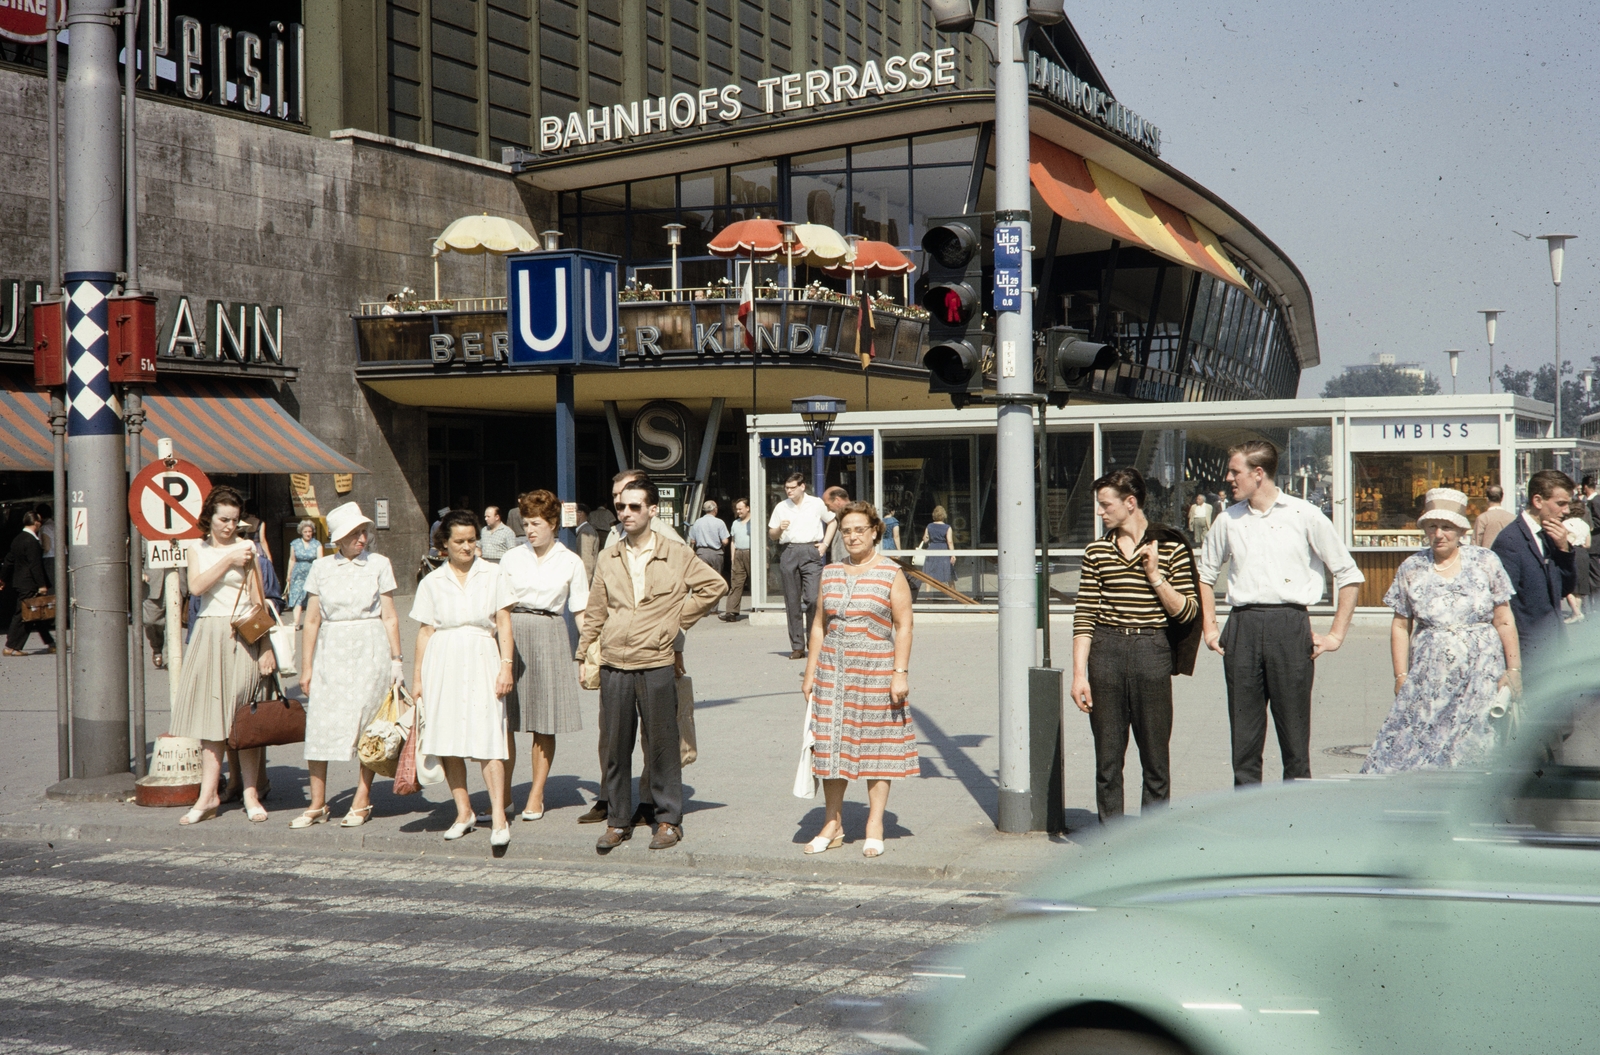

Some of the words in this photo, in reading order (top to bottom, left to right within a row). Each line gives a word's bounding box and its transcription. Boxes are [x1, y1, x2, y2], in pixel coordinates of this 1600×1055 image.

[539, 84, 743, 152] BAHNHOFS
[757, 47, 956, 114] TERRASSE
[996, 232, 1009, 244] LH
[1010, 235, 1019, 243] 25
[996, 274, 1009, 285] LH
[1010, 277, 1019, 285] 25
[519, 267, 567, 352] U
[584, 271, 614, 353] U
[697, 322, 834, 355] KINDL
[815, 401, 829, 411] Ruf
[637, 408, 682, 470] S
[1382, 423, 1469, 439] IMBISS
[828, 437, 866, 455] Zoo
[72, 490, 84, 503] 32
[162, 477, 189, 529] P
